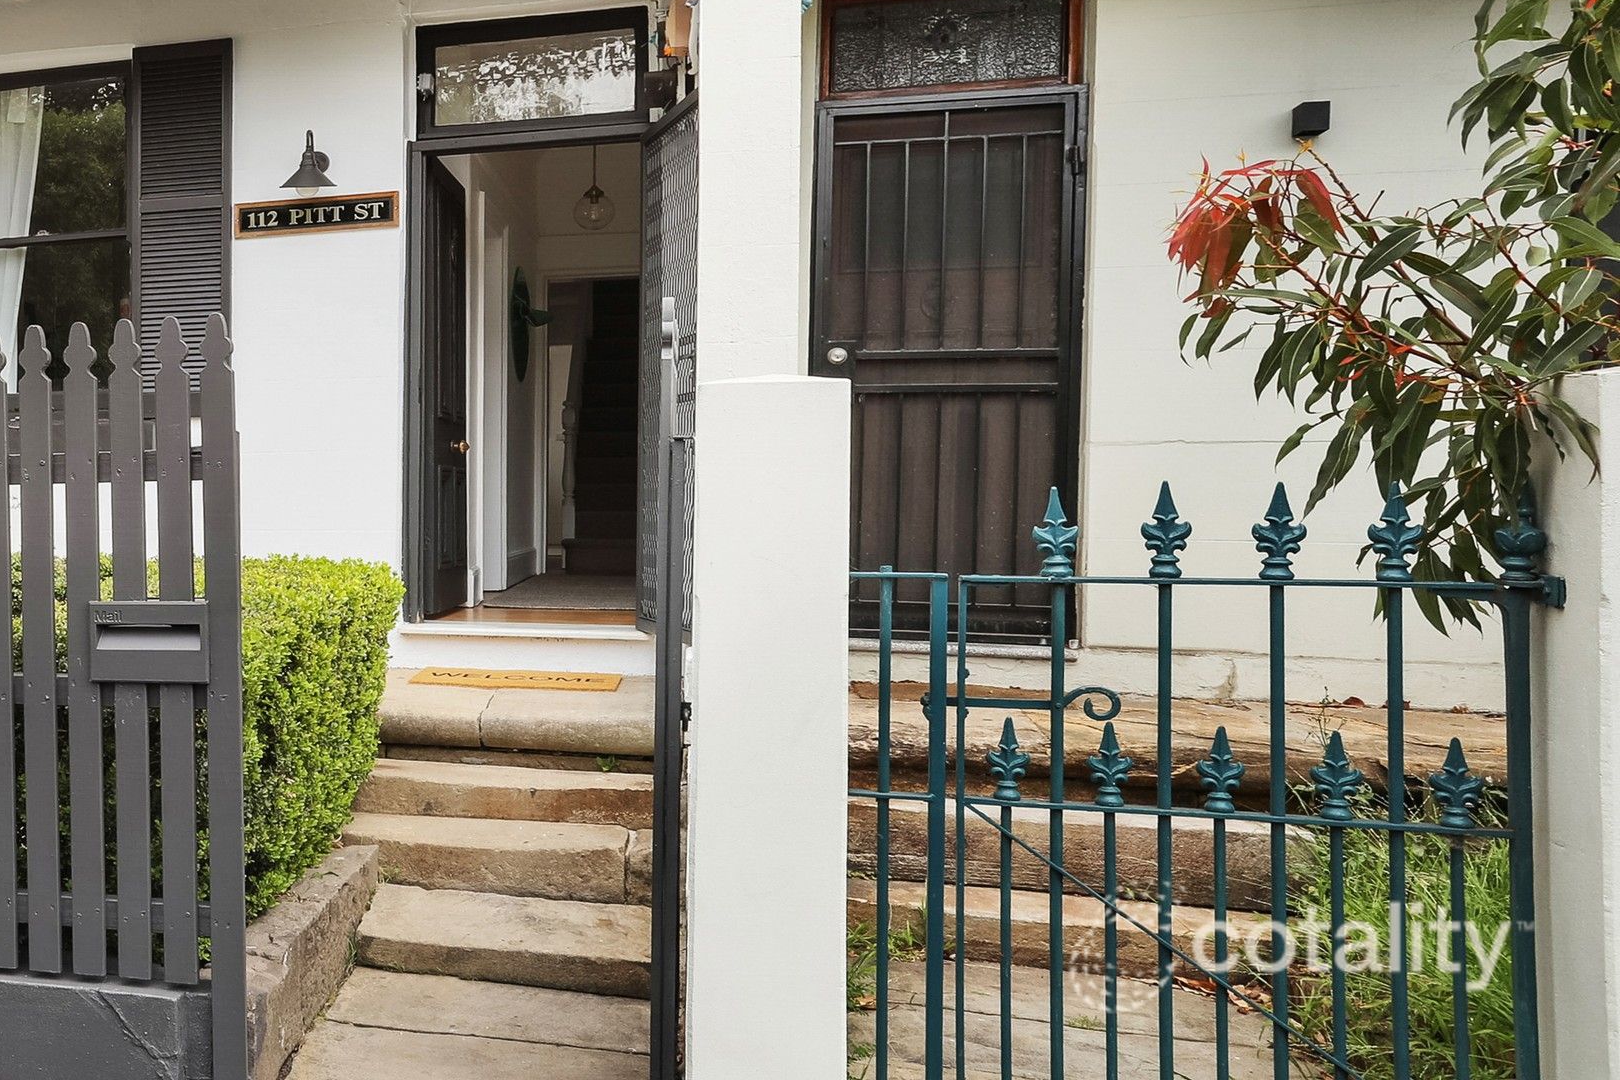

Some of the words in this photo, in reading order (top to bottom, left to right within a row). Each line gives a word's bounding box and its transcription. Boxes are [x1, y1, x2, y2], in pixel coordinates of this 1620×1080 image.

[247, 211, 278, 228] 112
[288, 205, 345, 225] PITT
[354, 202, 384, 220] ST
[94, 610, 122, 623] Mail
[431, 672, 605, 683] WELCOME
